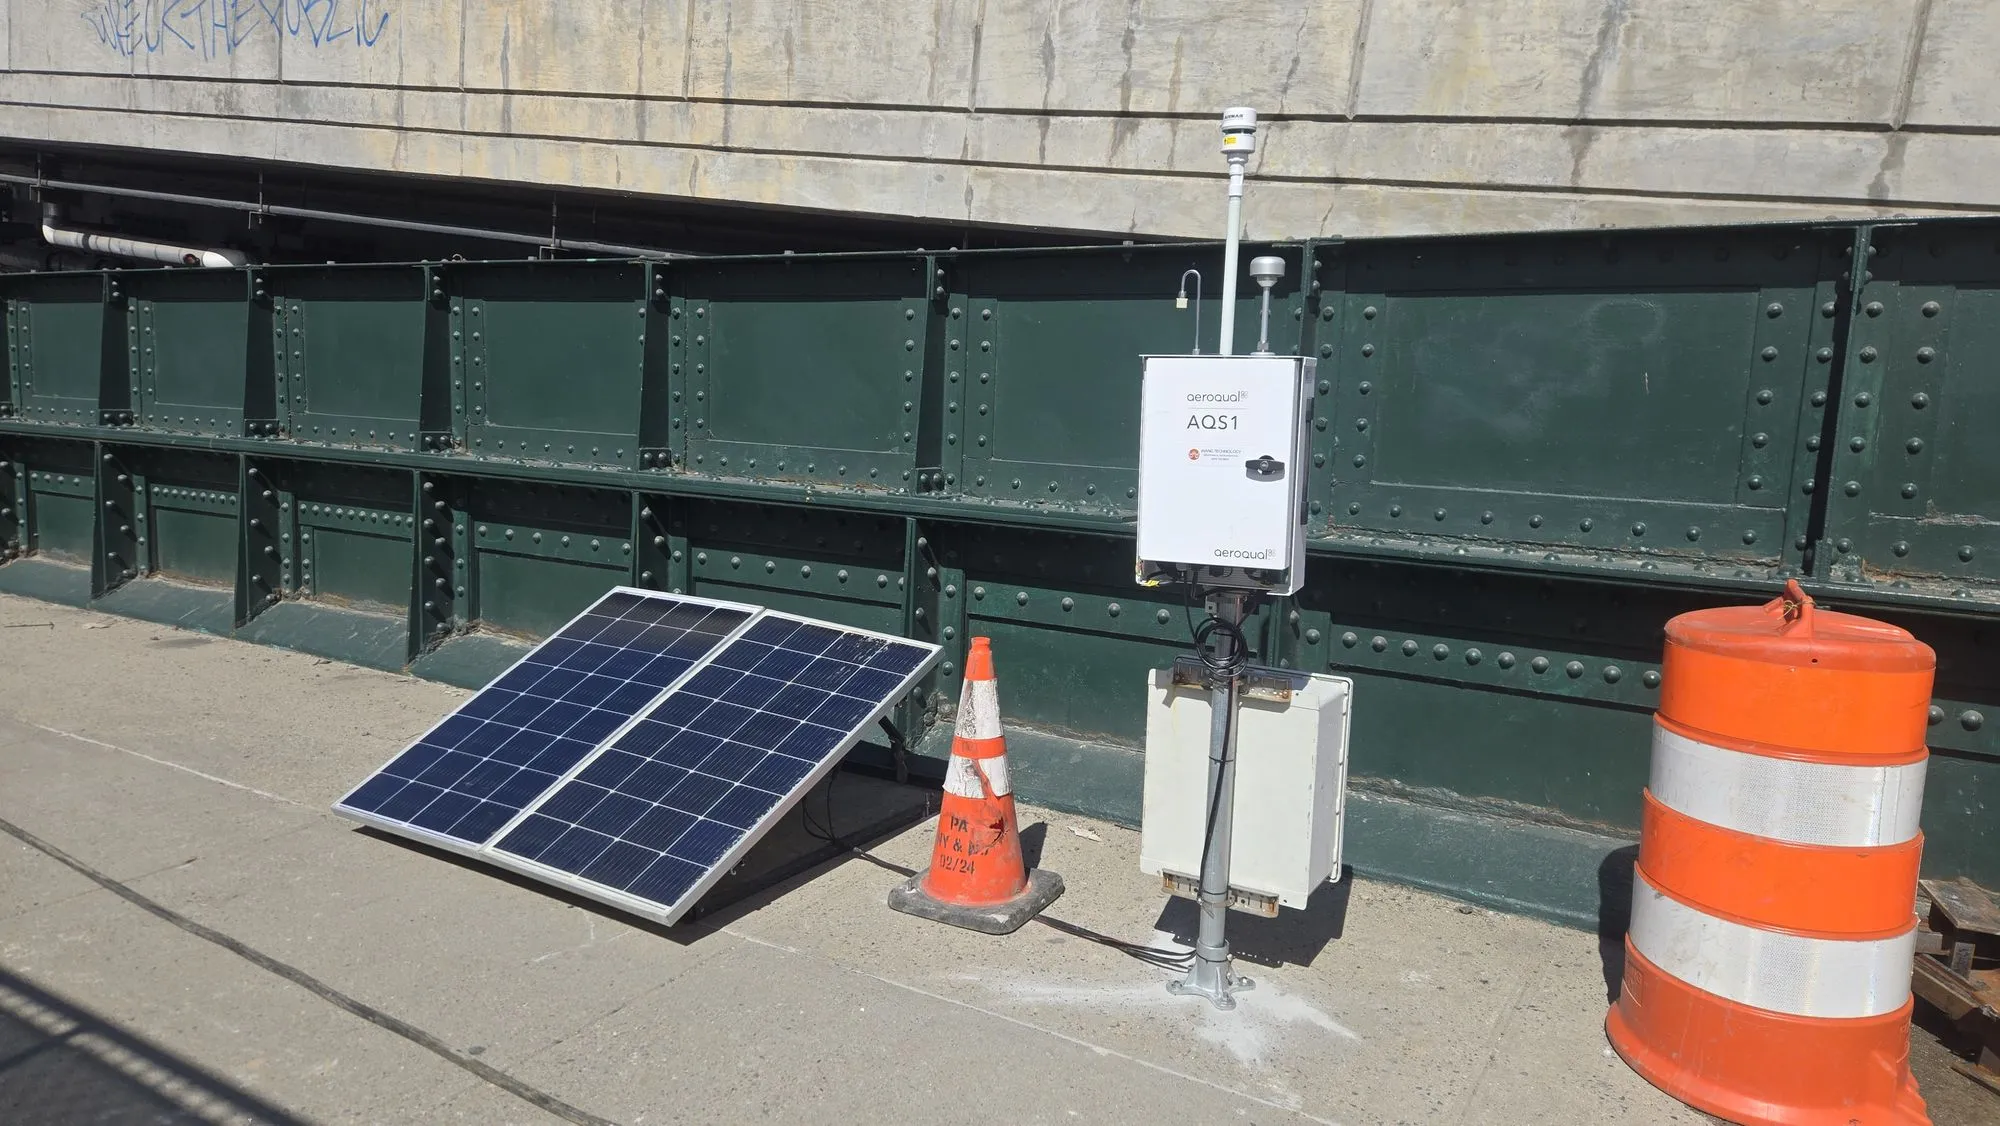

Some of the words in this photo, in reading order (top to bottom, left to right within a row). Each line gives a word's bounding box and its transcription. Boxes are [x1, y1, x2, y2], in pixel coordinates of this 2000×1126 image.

[1186, 390, 1241, 402] aeroqual
[1186, 414, 1238, 430] AQS1
[1213, 548, 1268, 560] aeroqual
[950, 815, 968, 832] PA
[953, 838, 963, 852] &
[940, 854, 975, 874] 02/24
